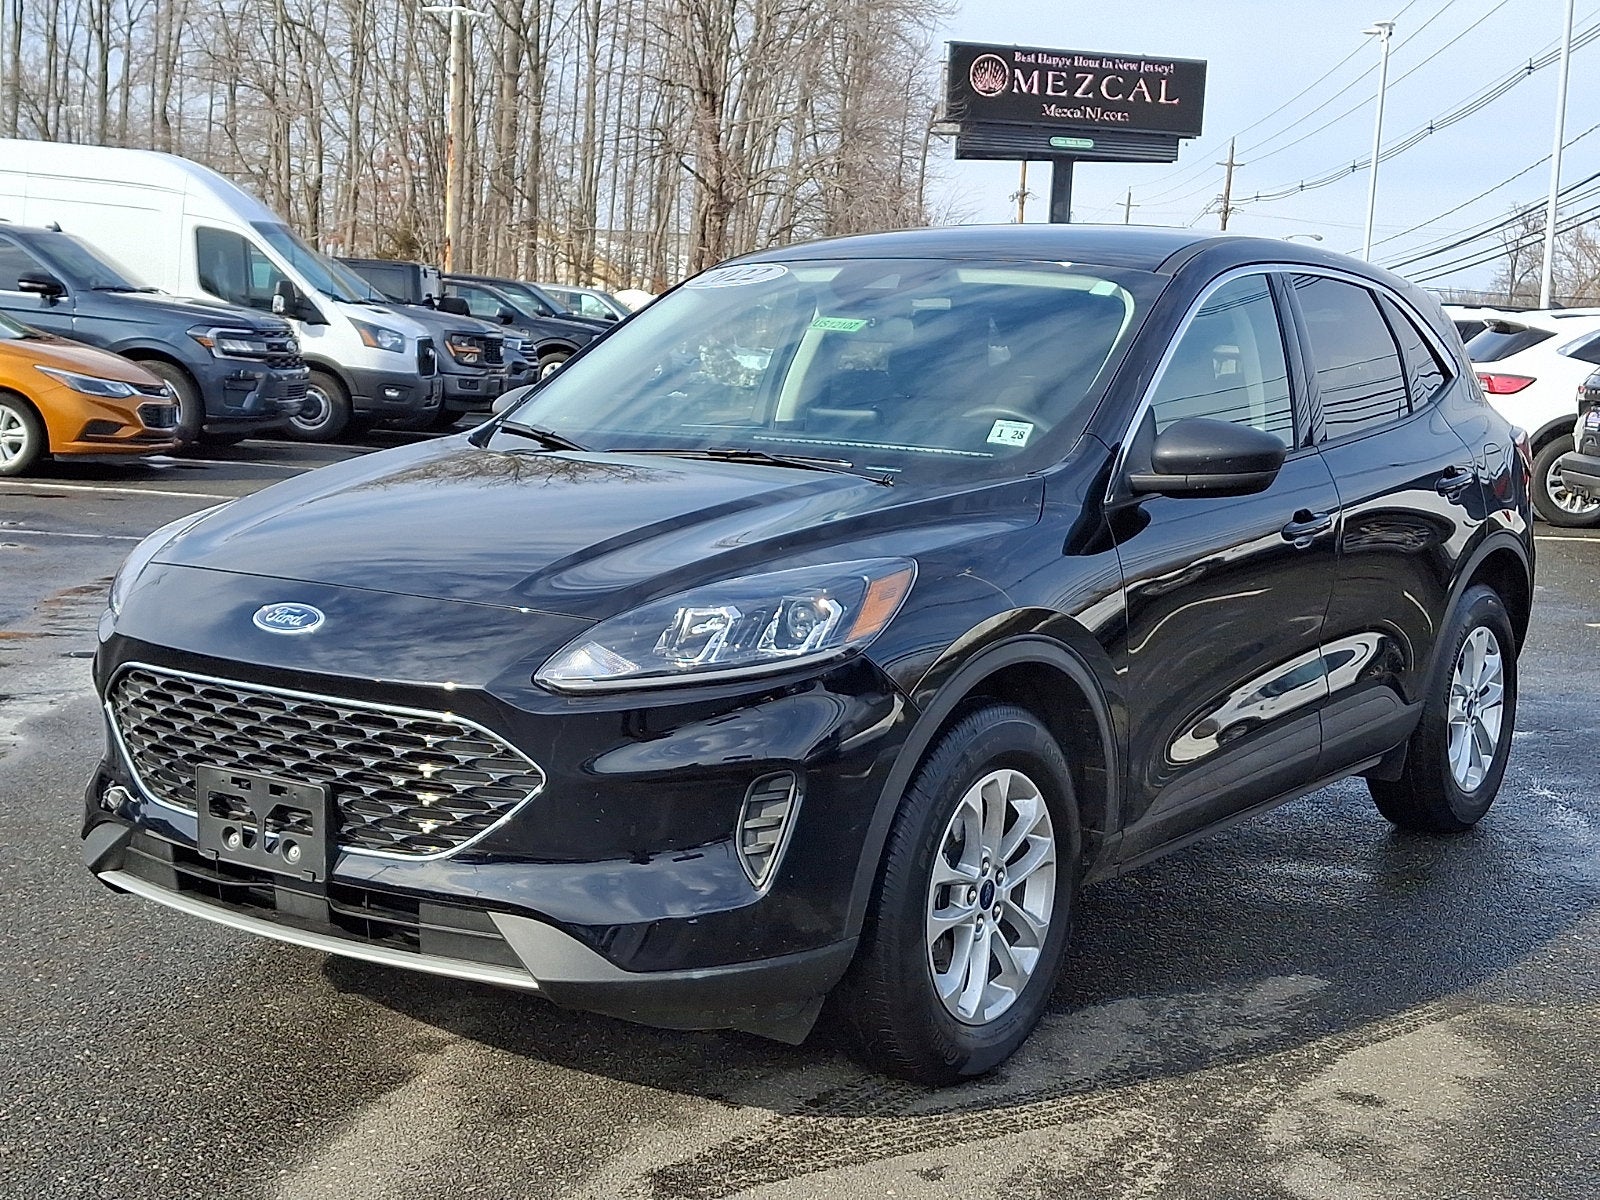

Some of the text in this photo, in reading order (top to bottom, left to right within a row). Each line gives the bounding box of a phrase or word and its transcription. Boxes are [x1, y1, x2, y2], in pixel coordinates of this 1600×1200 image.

[1014, 51, 1036, 63] Best
[1037, 53, 1072, 68] Happy
[1073, 55, 1100, 68] Hour
[1114, 59, 1138, 71] New
[1140, 61, 1174, 75] Jersey!
[1011, 68, 1180, 105] MEZCAL
[1041, 103, 1130, 121] MezcalNJ.com
[996, 429, 1026, 440] 1 28
[265, 606, 308, 626] Ford
